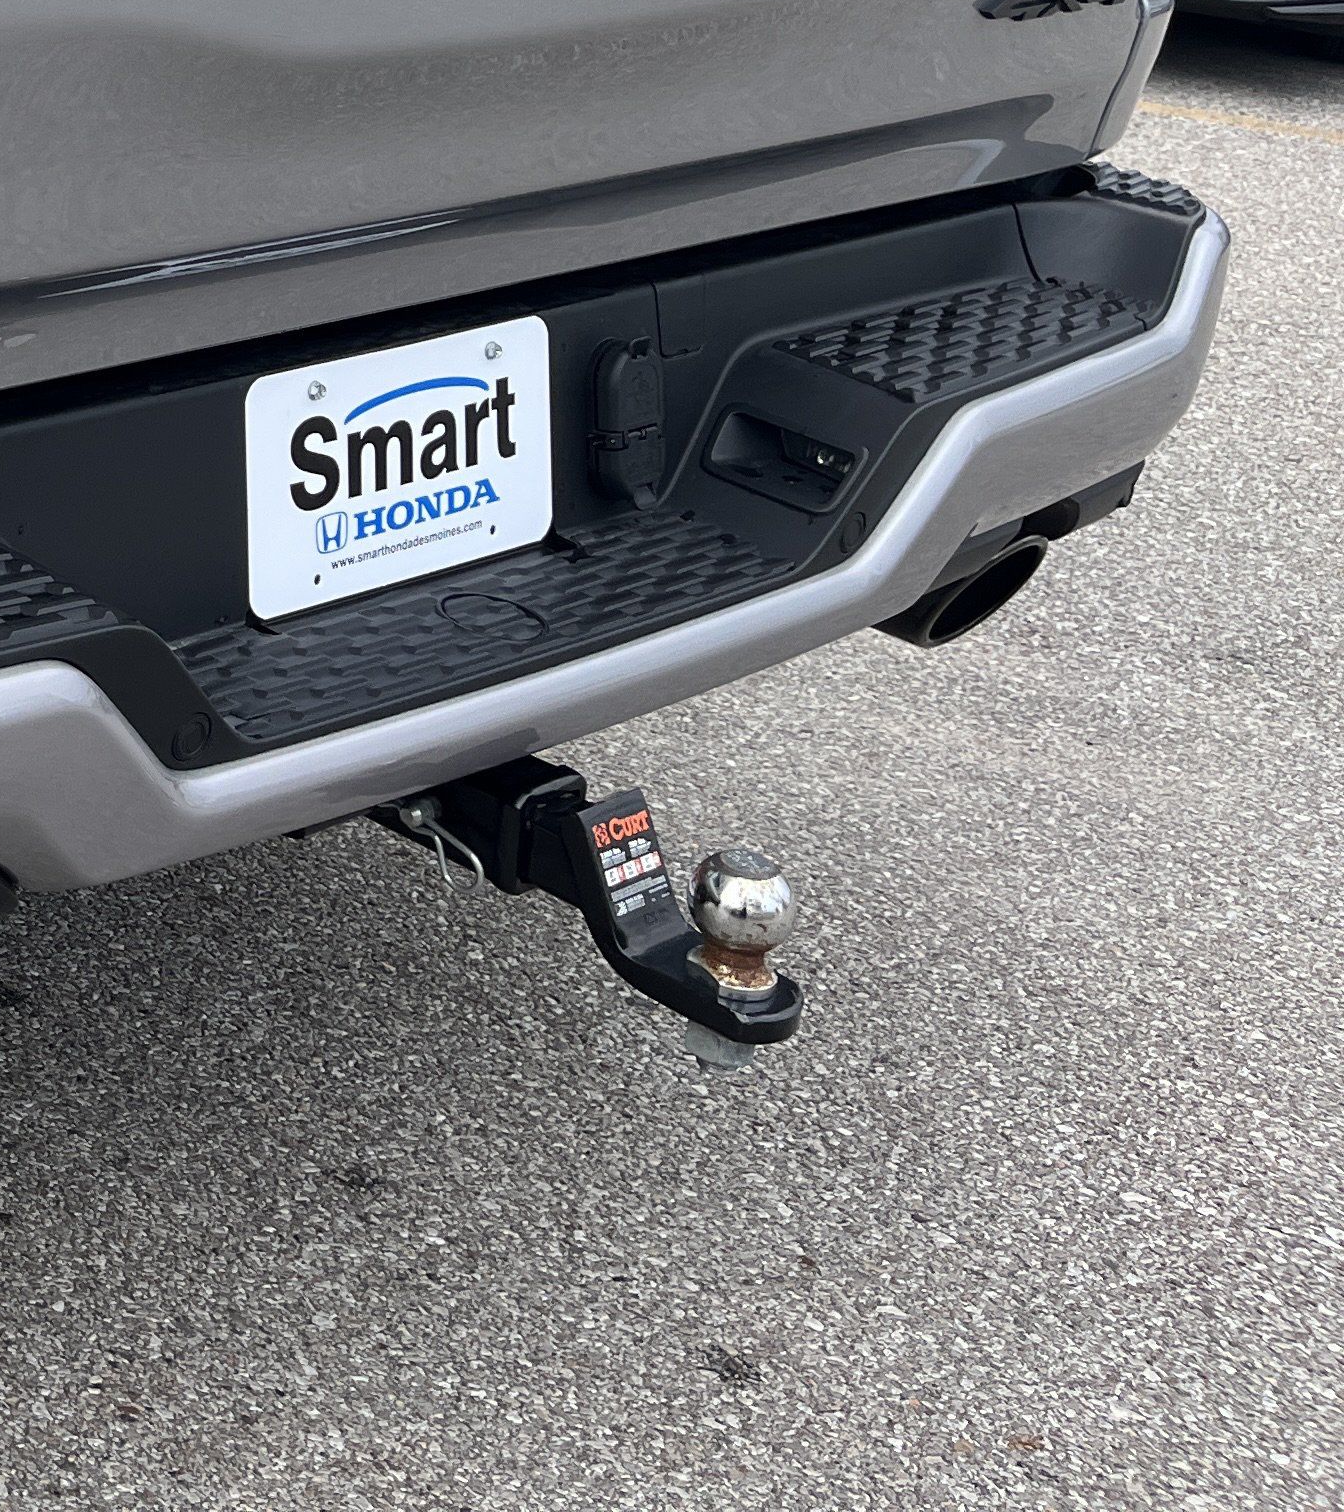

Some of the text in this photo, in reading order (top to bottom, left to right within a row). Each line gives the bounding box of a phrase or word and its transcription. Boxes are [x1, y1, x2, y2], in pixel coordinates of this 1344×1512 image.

[289, 376, 517, 512] Smart
[354, 478, 500, 540] HONDA
[331, 519, 483, 570] www.smarthondadesmoines.com
[609, 810, 650, 841] CURT
